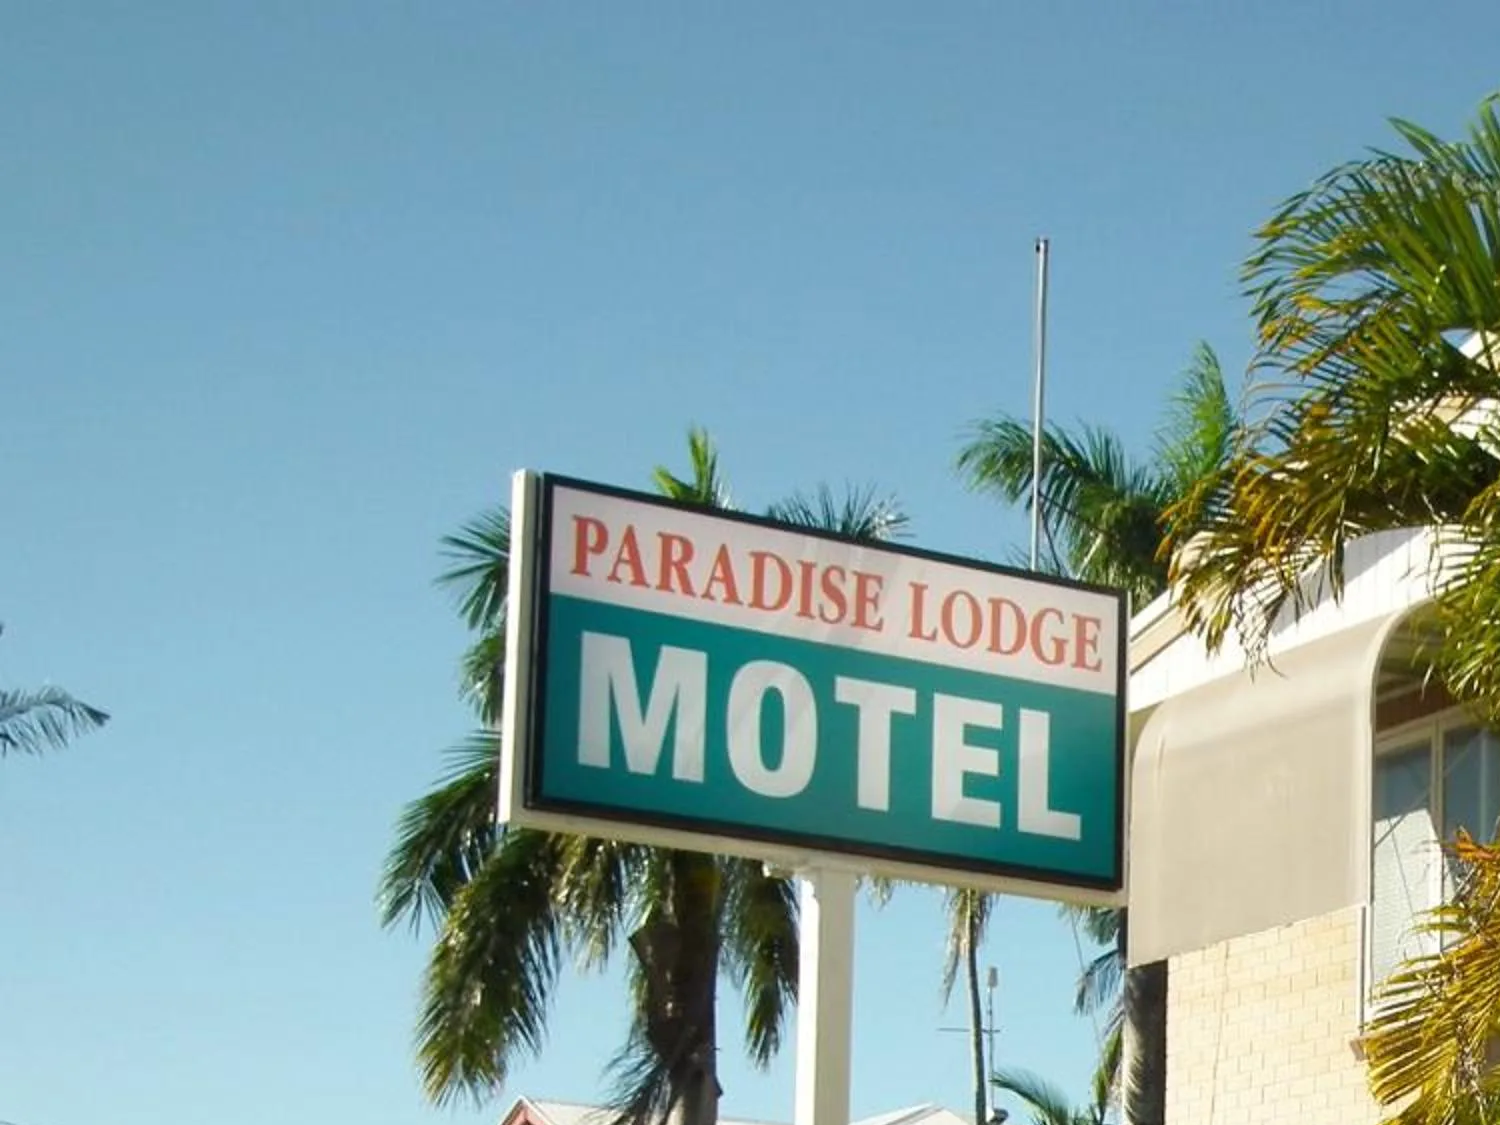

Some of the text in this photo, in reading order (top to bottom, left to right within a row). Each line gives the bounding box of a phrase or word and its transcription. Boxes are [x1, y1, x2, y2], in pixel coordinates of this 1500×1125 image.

[570, 513, 1103, 673] PARADISE LODGE
[577, 630, 1083, 842] MOTEL
